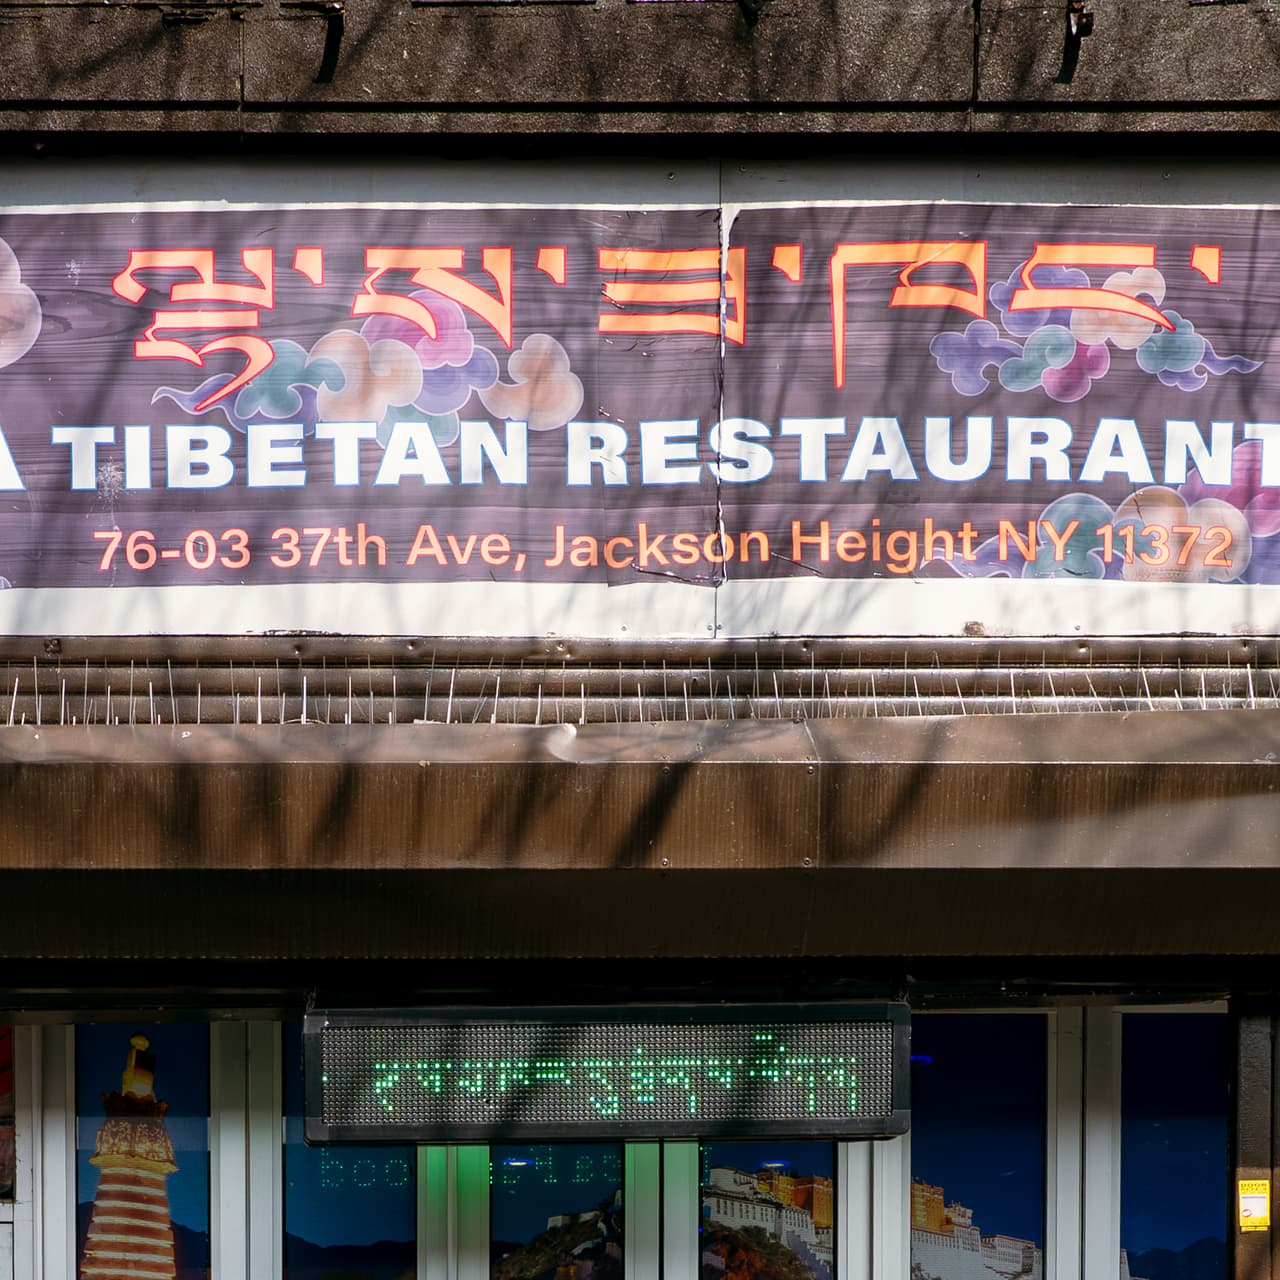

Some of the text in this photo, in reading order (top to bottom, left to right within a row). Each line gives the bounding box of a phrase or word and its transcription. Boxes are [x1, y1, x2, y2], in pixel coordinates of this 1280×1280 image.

[52, 421, 528, 490] TIBETAN
[93, 519, 1233, 574] 76-03 37th Ave, Jackson Height NY 11372
